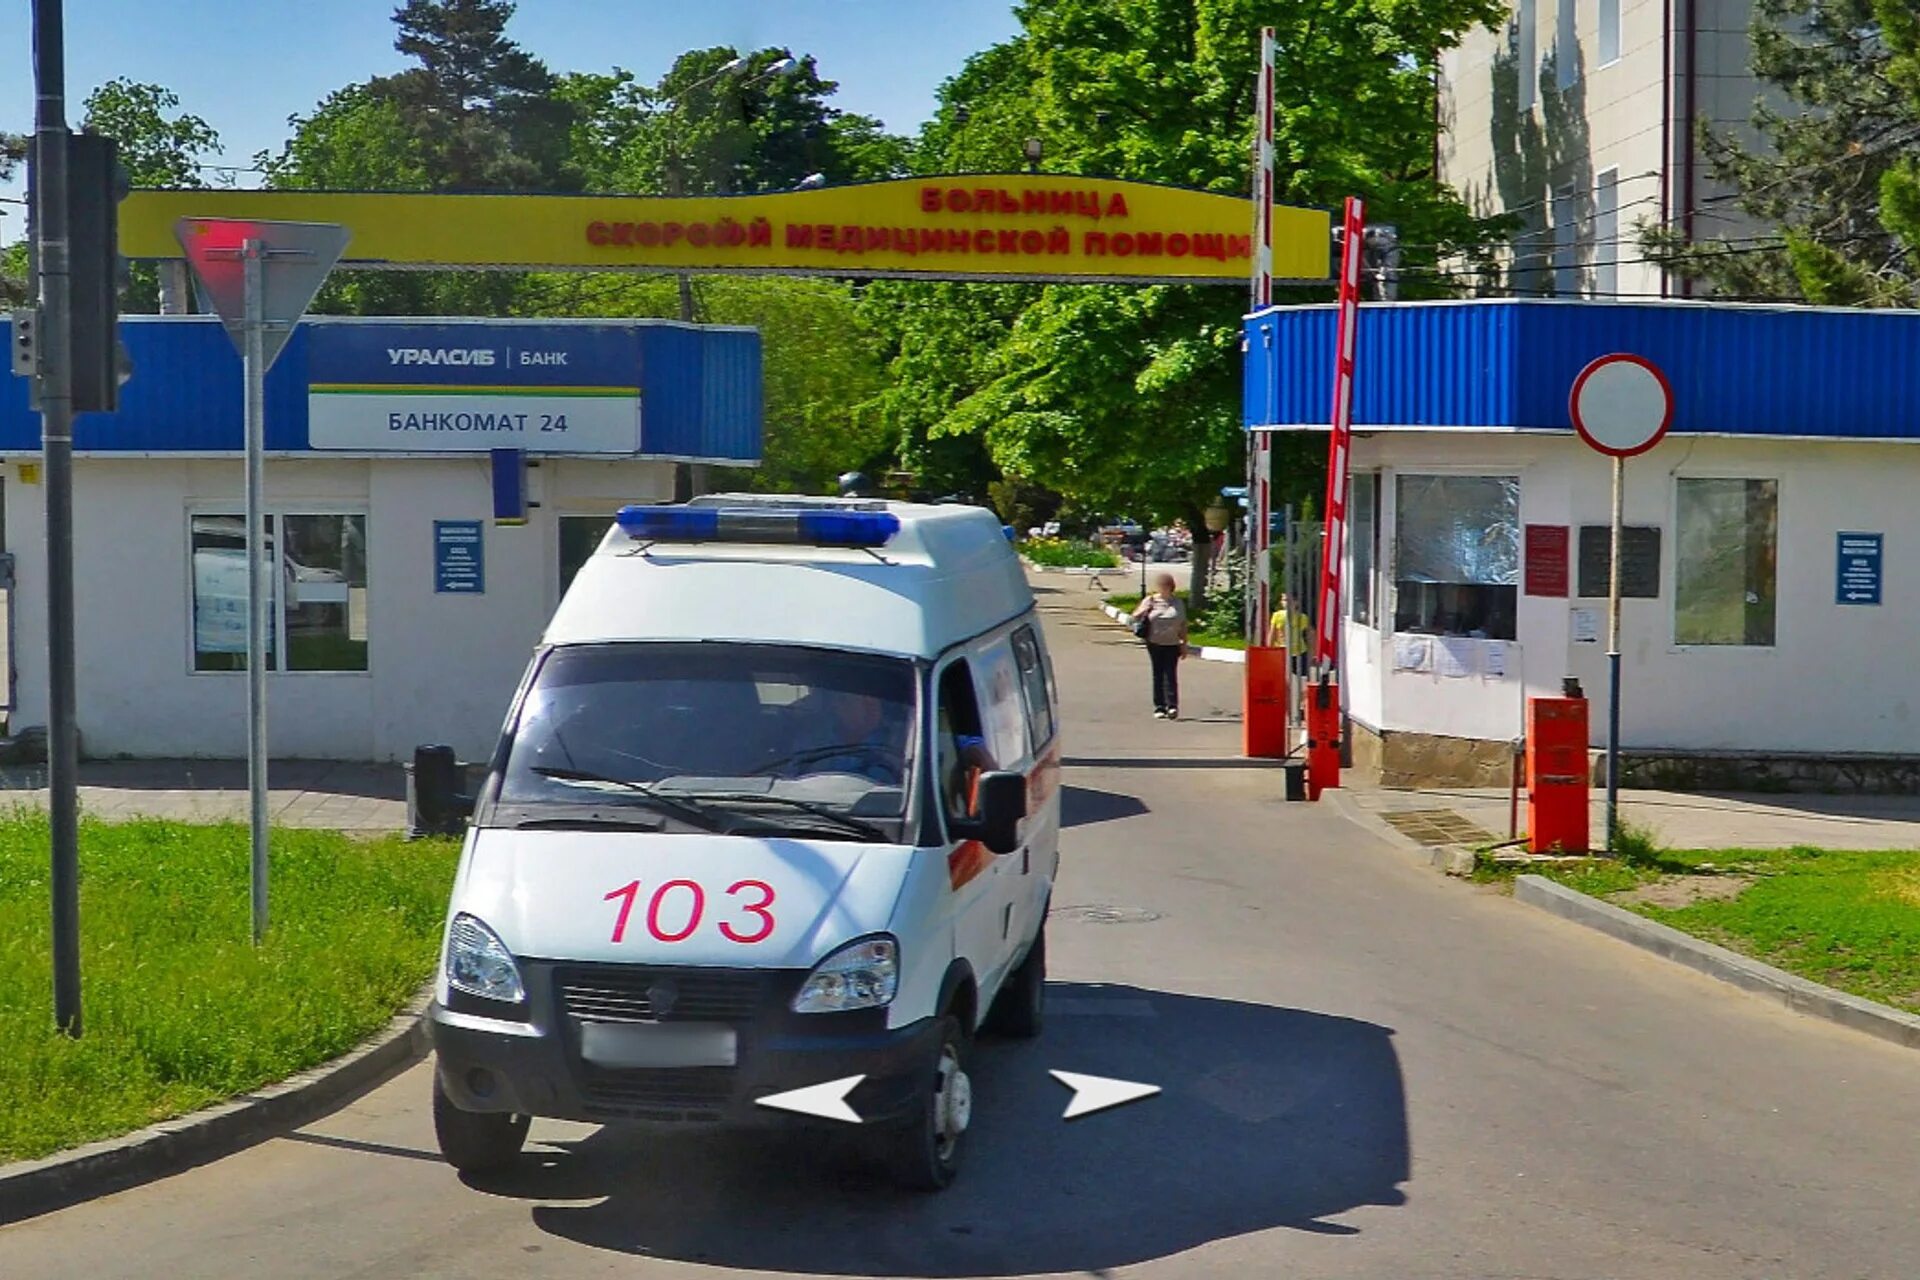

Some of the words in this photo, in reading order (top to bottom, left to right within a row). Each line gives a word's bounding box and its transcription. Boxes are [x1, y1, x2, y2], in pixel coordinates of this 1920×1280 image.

[920, 187, 1129, 220] БОЛЬНИЦА
[784, 222, 1071, 256] МЕДИЦИНСКОЙ
[1083, 231, 1253, 263] ПОМОЩИ
[387, 348, 496, 366] УРАЛСИБ
[520, 351, 569, 366] БАНК
[388, 412, 529, 433] БАНКОМАТ
[539, 413, 569, 433] 24
[602, 878, 777, 944] 103
